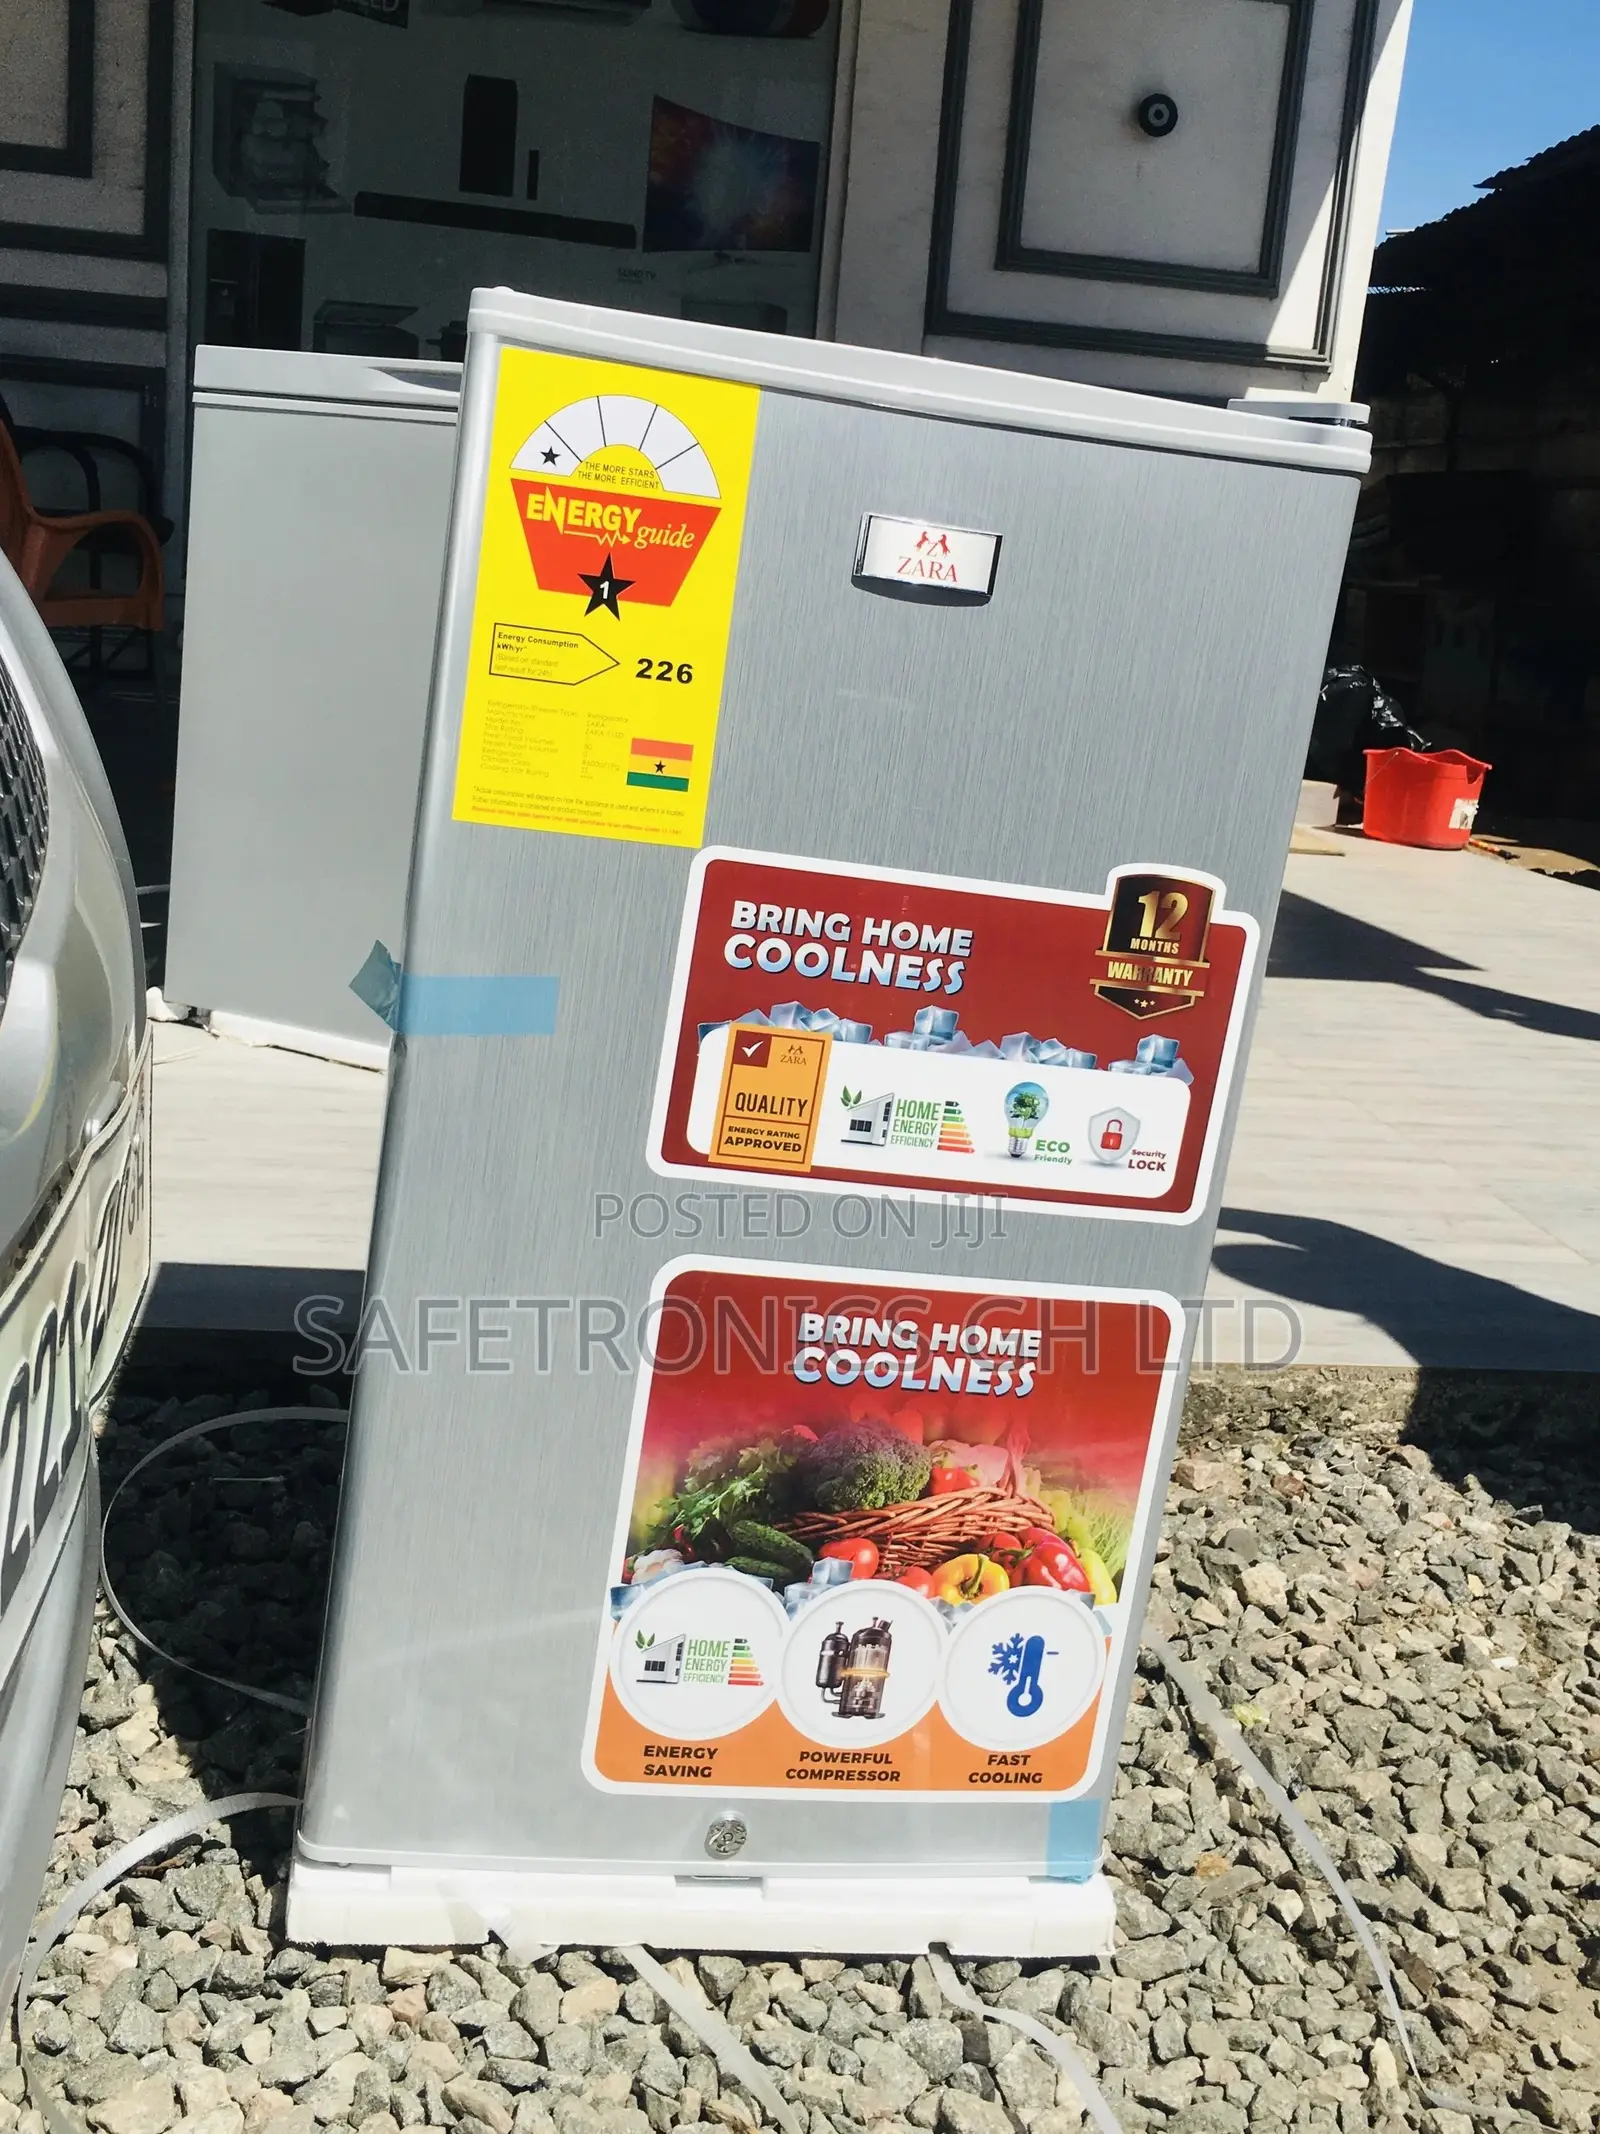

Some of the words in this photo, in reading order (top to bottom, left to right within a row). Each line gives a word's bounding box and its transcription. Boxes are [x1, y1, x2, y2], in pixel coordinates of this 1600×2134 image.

[585, 461, 601, 471] THE
[603, 463, 626, 475] MORE
[628, 466, 655, 479] STARS
[578, 470, 593, 480] THE
[595, 473, 616, 484] MORE
[621, 477, 659, 489] EFFICIENT
[526, 486, 642, 535] ENERGY
[633, 524, 695, 549] guide
[897, 556, 957, 582] ZARA
[599, 580, 609, 599] 1
[498, 632, 526, 643] Energy
[527, 636, 579, 650] Consumption
[635, 657, 694, 684] 226
[1138, 890, 1188, 940] 12
[730, 900, 852, 943] BRING
[861, 917, 974, 957] HOME
[1130, 938, 1180, 954] MONTHS
[723, 933, 965, 995] COOLNESS
[1107, 961, 1193, 987] WARRANTY
[734, 1092, 808, 1118] QUALITY
[896, 1098, 942, 1121] HOME
[728, 1125, 765, 1136] ENERGY
[766, 1130, 800, 1139] RATING
[893, 1120, 938, 1137] ENERGY
[724, 1136, 802, 1152] APPROVED
[890, 1135, 935, 1148] EFFICIENCY
[1035, 1139, 1071, 1153] ECO
[1034, 1154, 1072, 1166] Friendly
[1131, 1149, 1167, 1159] Security
[1128, 1159, 1166, 1172] LOCK
[798, 1311, 919, 1350] BRING
[929, 1322, 1042, 1358] HOME
[792, 1346, 1037, 1397] COOLNESS
[688, 1639, 730, 1658] HOME
[685, 1658, 727, 1673] ENERGY
[683, 1672, 724, 1684] EFFICIENCY
[643, 1745, 718, 1760] ENERGY
[799, 1751, 893, 1765] POWERFUL
[987, 1754, 1031, 1766] FAST
[643, 1764, 713, 1778] SAVING
[785, 1768, 901, 1782] COMPRESSOR
[968, 1771, 1043, 1784] COOLING
